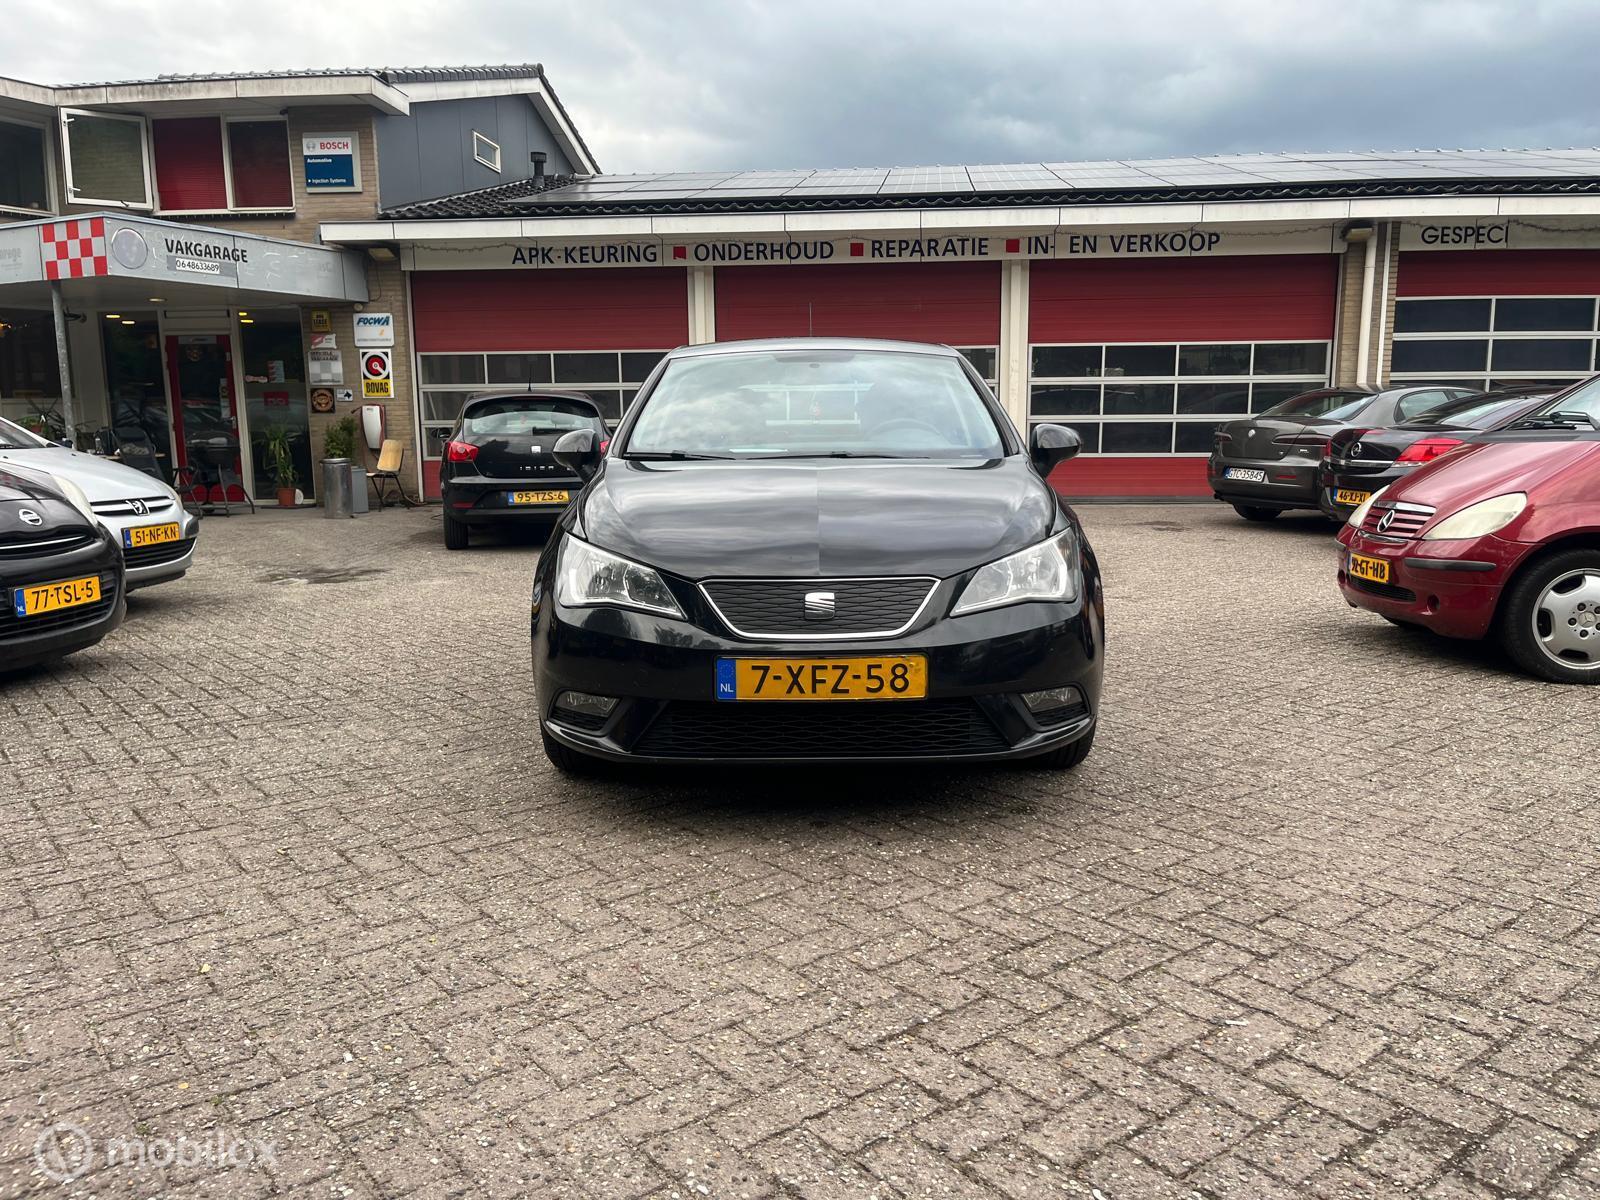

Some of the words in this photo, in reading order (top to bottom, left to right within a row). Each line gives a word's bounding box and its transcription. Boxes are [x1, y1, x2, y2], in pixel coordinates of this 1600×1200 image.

[320, 142, 349, 150] BOSCH
[165, 238, 248, 263] VAKGARAGE
[694, 241, 834, 262] ONDERHOUD
[871, 238, 989, 258] REPARATIE
[1069, 235, 1097, 254] EN
[1109, 233, 1220, 253] VERKOOP
[176, 258, 219, 272] 0648633689
[357, 316, 390, 326] FOCWA
[366, 382, 389, 394] BOVAG
[517, 491, 564, 502] 95-TZS-6
[136, 525, 177, 544] 51-NF-KN
[32, 581, 94, 610] 77-TSL-5
[720, 683, 734, 693] NL
[751, 663, 910, 694] 7-XFZ-58
